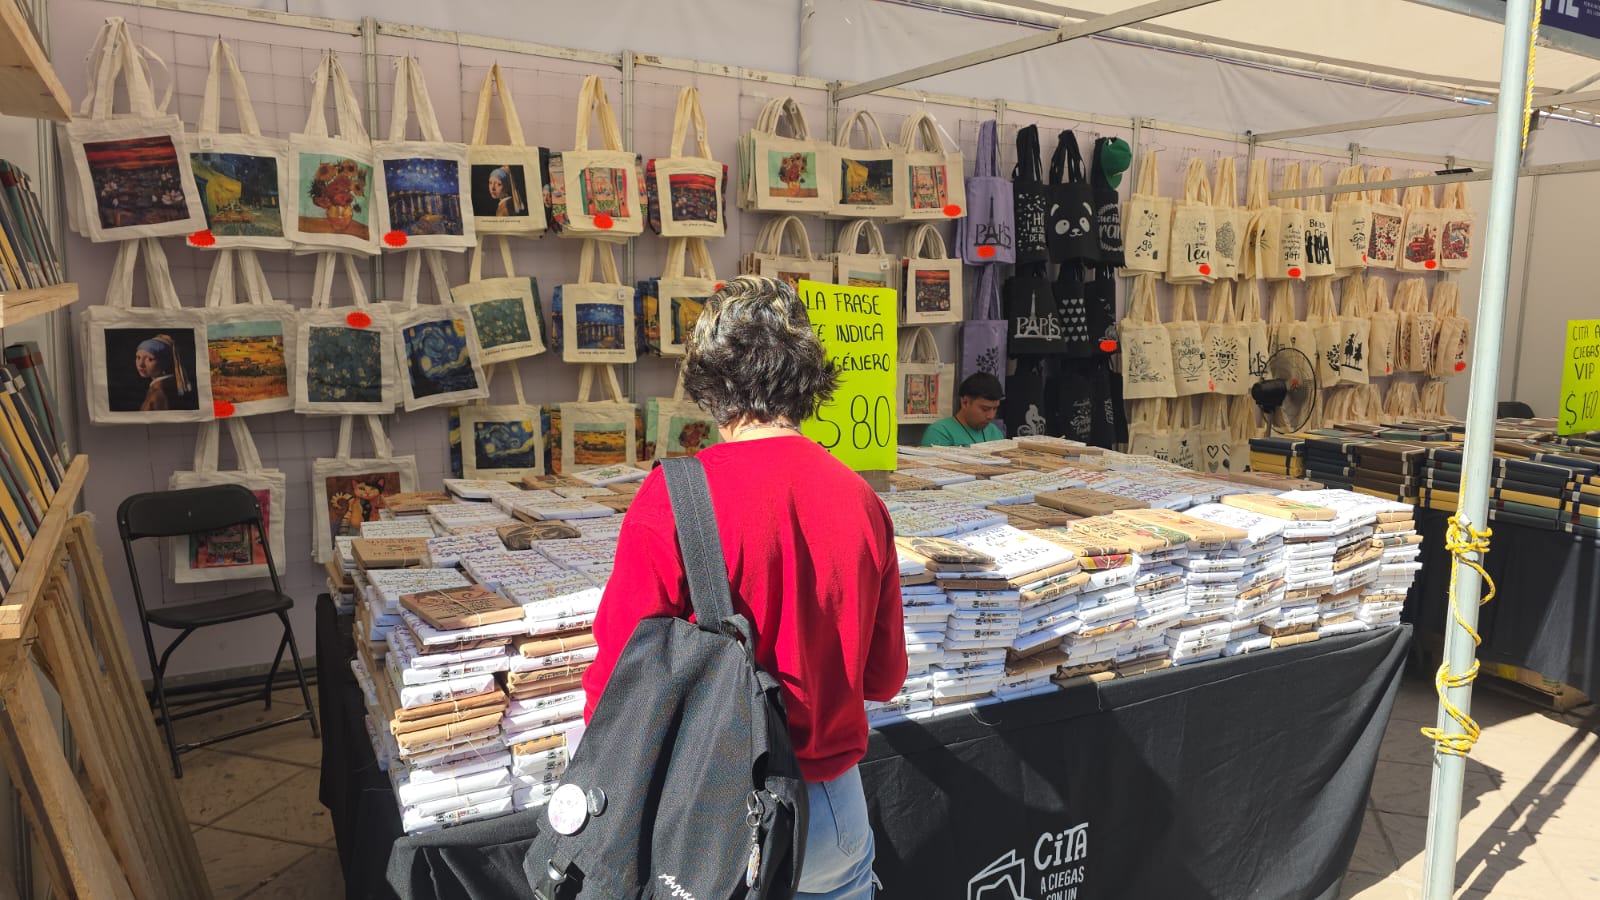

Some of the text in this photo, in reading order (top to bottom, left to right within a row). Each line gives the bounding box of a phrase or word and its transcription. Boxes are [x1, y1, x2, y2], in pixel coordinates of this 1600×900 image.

[805, 290, 882, 316] LA FRASE
[811, 322, 884, 343] E INDICA
[1572, 325, 1589, 341] CITA
[1572, 344, 1600, 360] CIEGAS
[833, 353, 890, 372] GÉNERO
[1574, 362, 1596, 381] VIP
[1040, 865, 1085, 895] A CIEGAS
